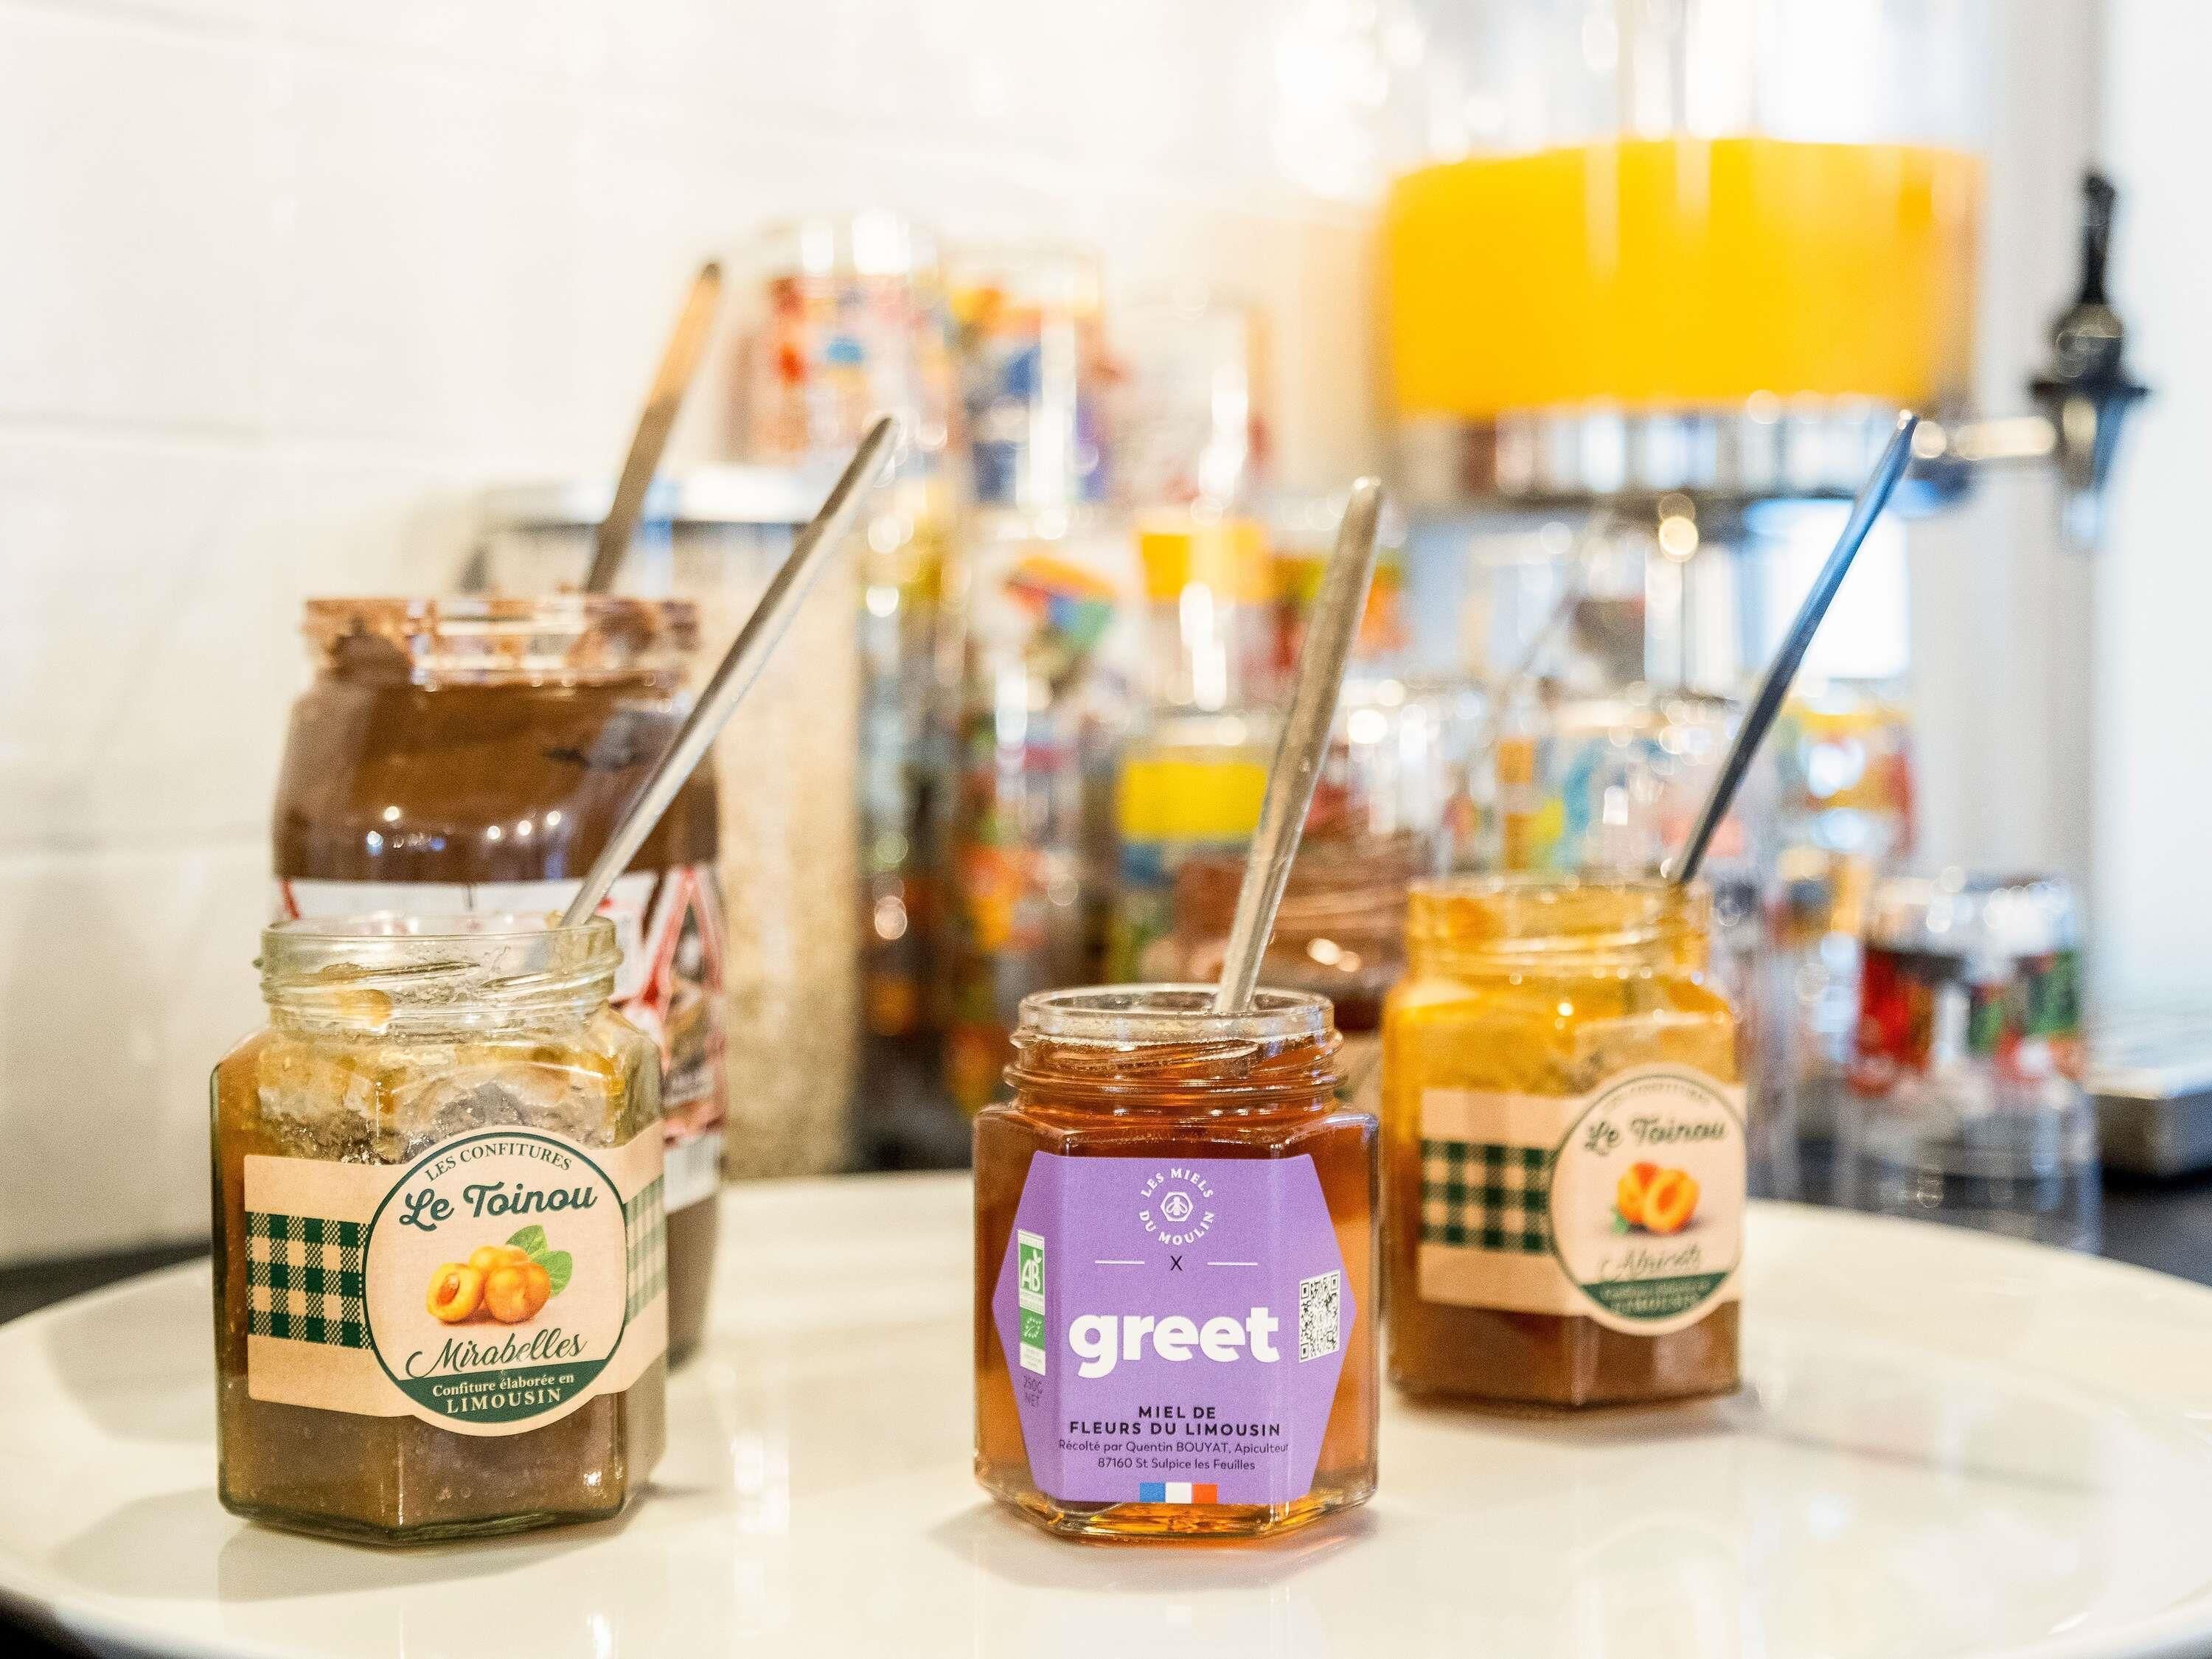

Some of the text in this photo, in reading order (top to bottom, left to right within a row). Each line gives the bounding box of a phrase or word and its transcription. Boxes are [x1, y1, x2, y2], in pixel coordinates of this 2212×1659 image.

[424, 1142, 573, 1182] LES CONFITURES
[1140, 1167, 1214, 1198] LES MIELS
[399, 1180, 598, 1232] Le Toinou
[1138, 1209, 1215, 1246] DU MOULIN
[405, 1327, 588, 1380] Mirabelles
[1068, 1306, 1281, 1379] greet
[432, 1374, 574, 1398] Confiture élaborée en
[446, 1388, 563, 1415] LIMOUSIN
[1138, 1405, 1216, 1419] MIEL DE
[1069, 1421, 1281, 1437] FLEURS DU LIMOUSIN
[1059, 1439, 1289, 1455] Récolté par Quentin BOUYAT, Apiculteur
[1097, 1456, 1256, 1471] 87160 St Sulpice les Feuilles
